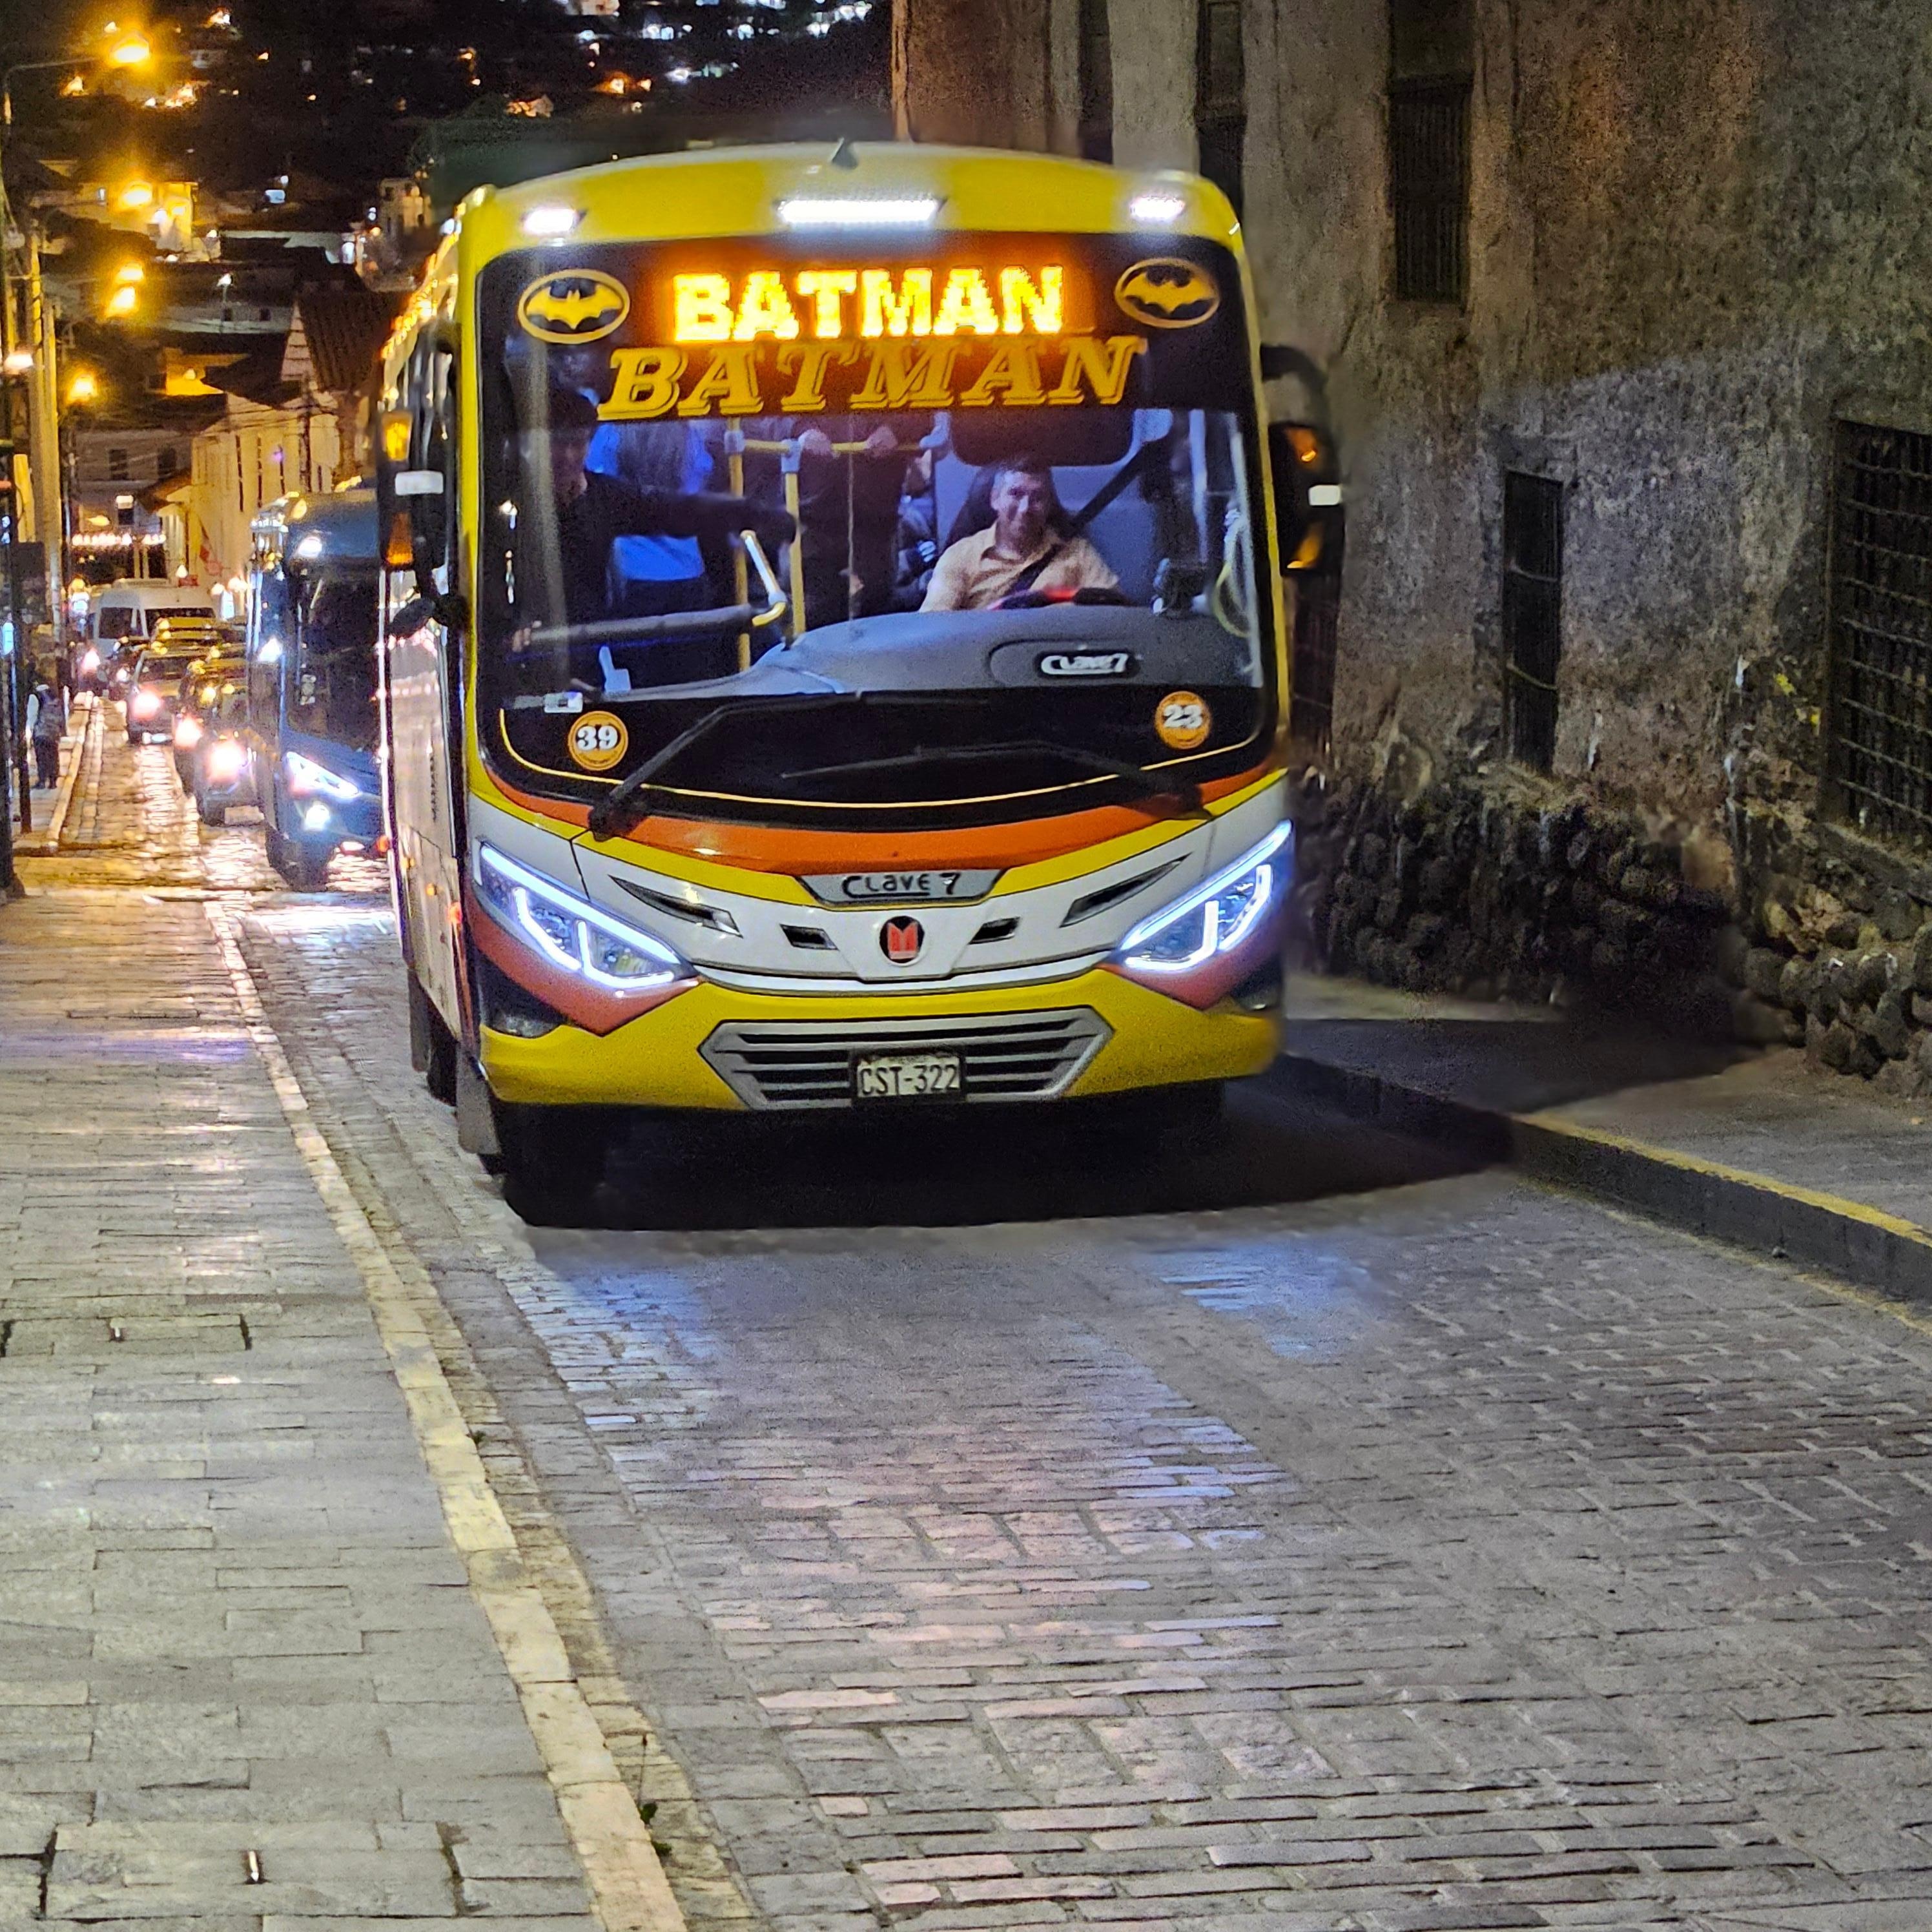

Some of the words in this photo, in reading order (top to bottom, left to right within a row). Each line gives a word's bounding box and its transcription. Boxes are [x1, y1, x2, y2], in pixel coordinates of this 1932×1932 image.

[673, 266, 1063, 341] BATMAN
[597, 336, 1147, 420] BATMAN
[577, 725, 618, 750] 39
[940, 872, 961, 895] 7
[861, 1064, 960, 1094] CST-322
